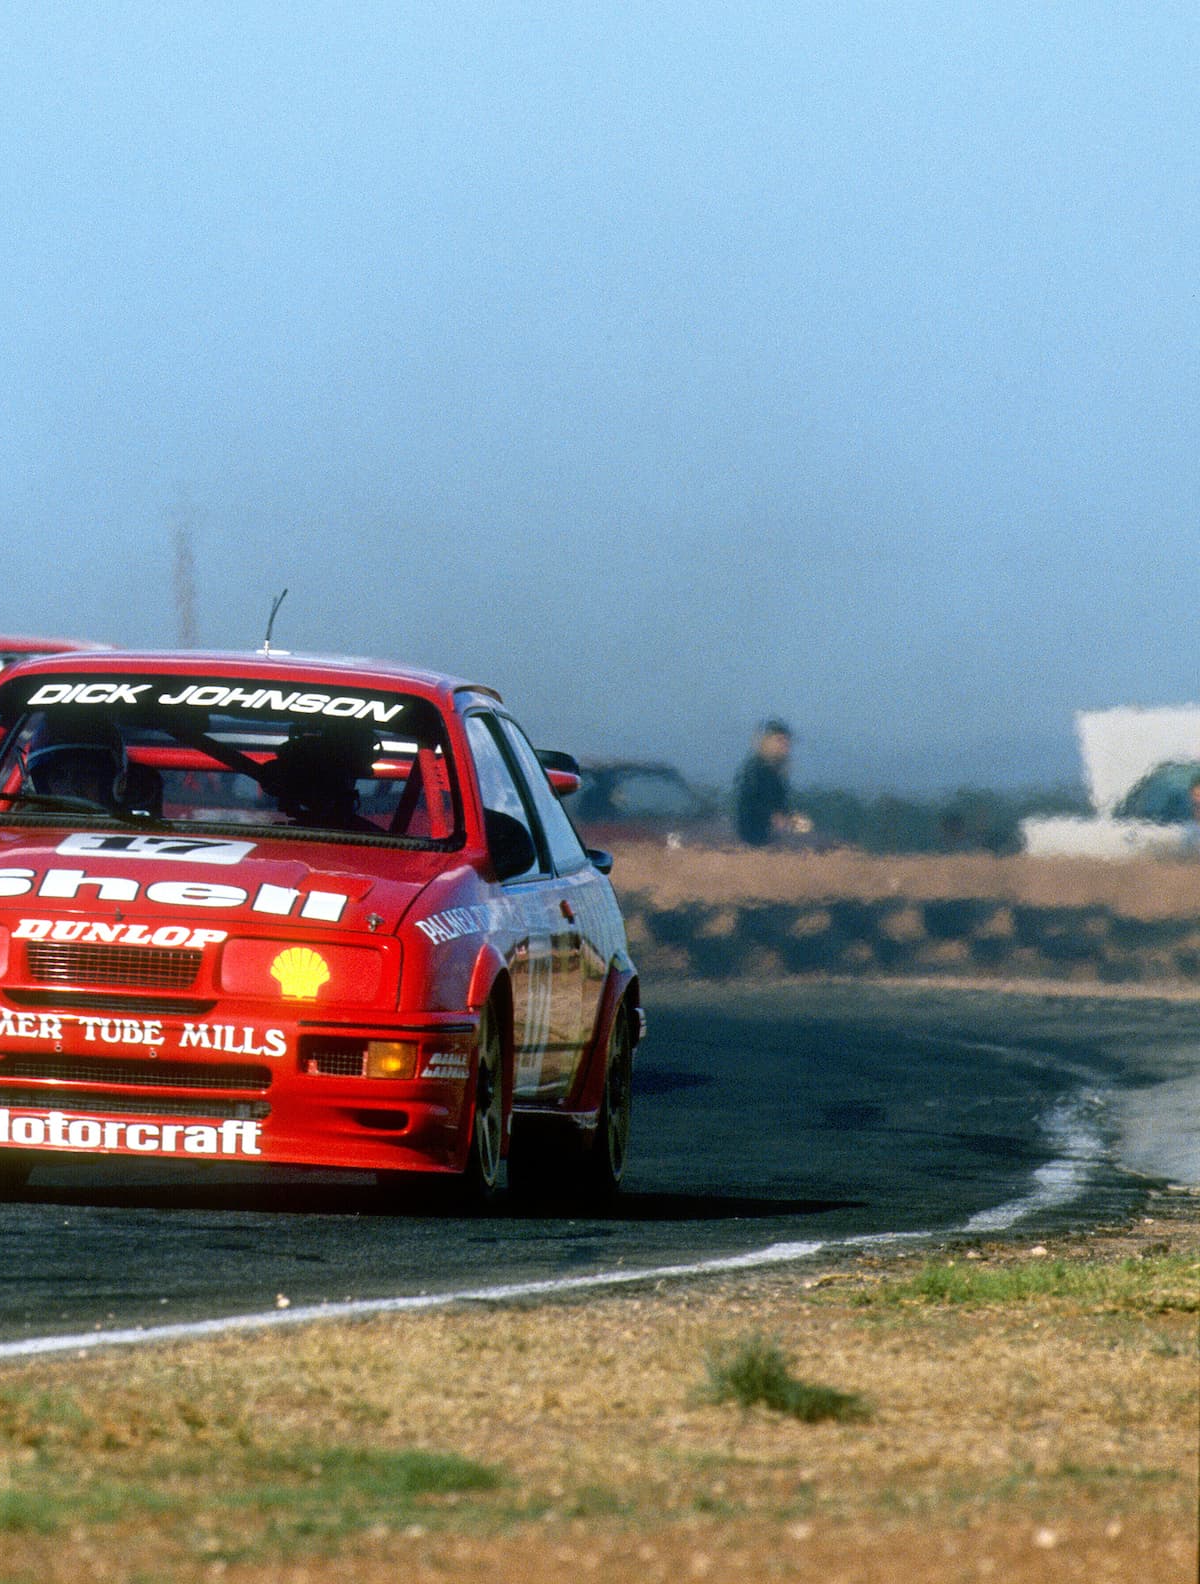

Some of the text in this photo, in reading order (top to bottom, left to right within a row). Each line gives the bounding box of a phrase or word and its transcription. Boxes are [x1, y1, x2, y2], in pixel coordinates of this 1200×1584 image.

[27, 683, 404, 722] DICK JOHNSON
[80, 837, 233, 855] 17
[11, 918, 228, 948] DUNLOP
[414, 906, 481, 945] PALMER
[78, 1015, 166, 1046] TUBE
[179, 1022, 287, 1057] MILLS
